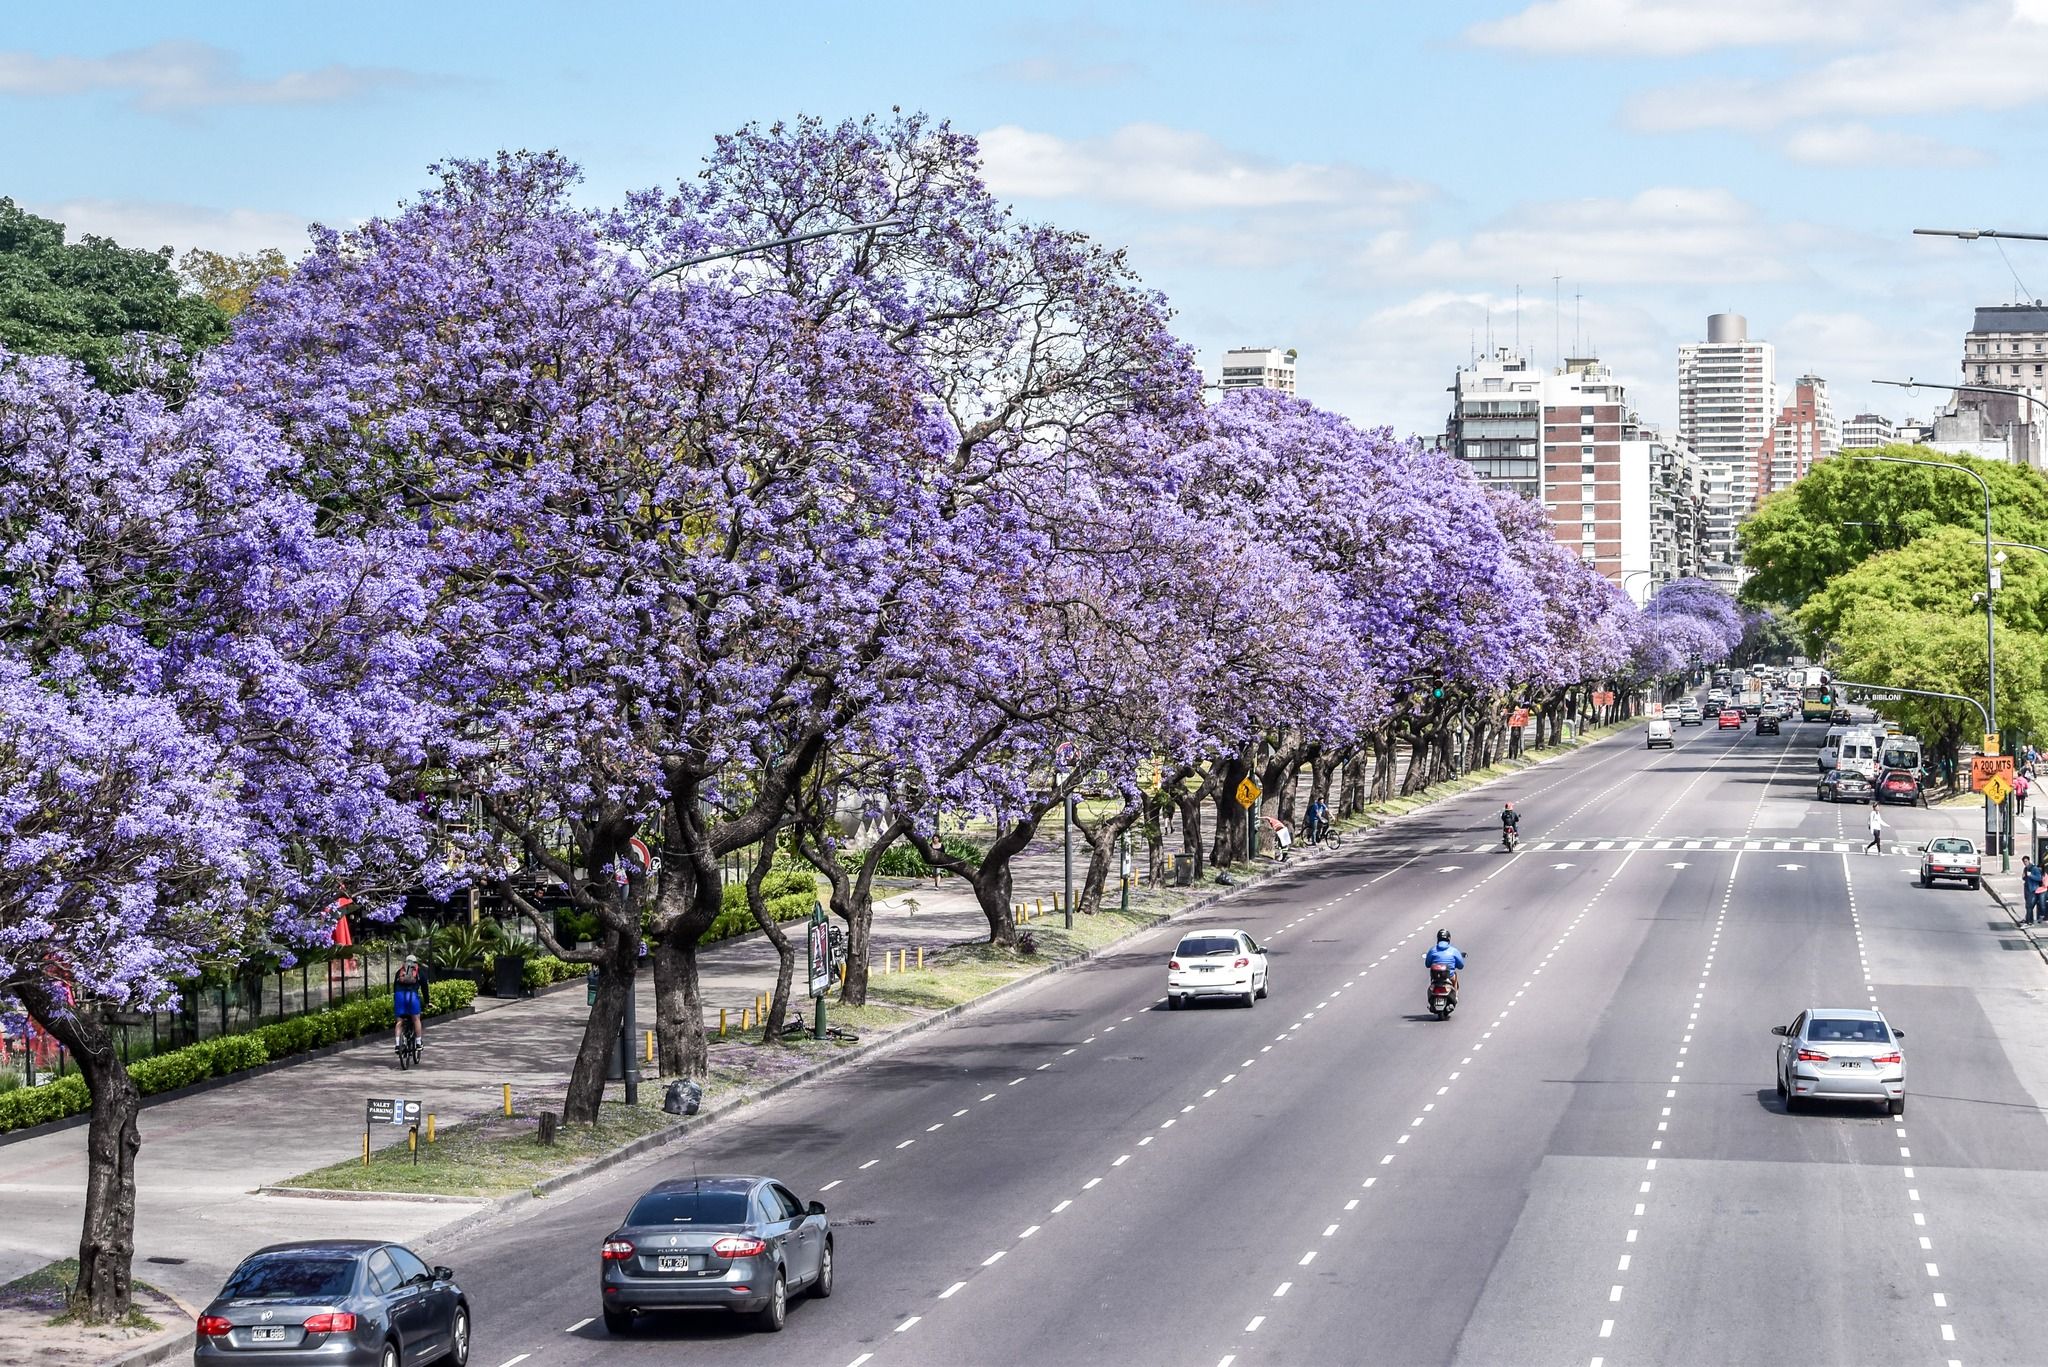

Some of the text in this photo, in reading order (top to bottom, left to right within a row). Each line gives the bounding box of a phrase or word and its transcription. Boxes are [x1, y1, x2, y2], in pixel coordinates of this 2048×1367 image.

[1974, 760, 2012, 770] A 200 MTS
